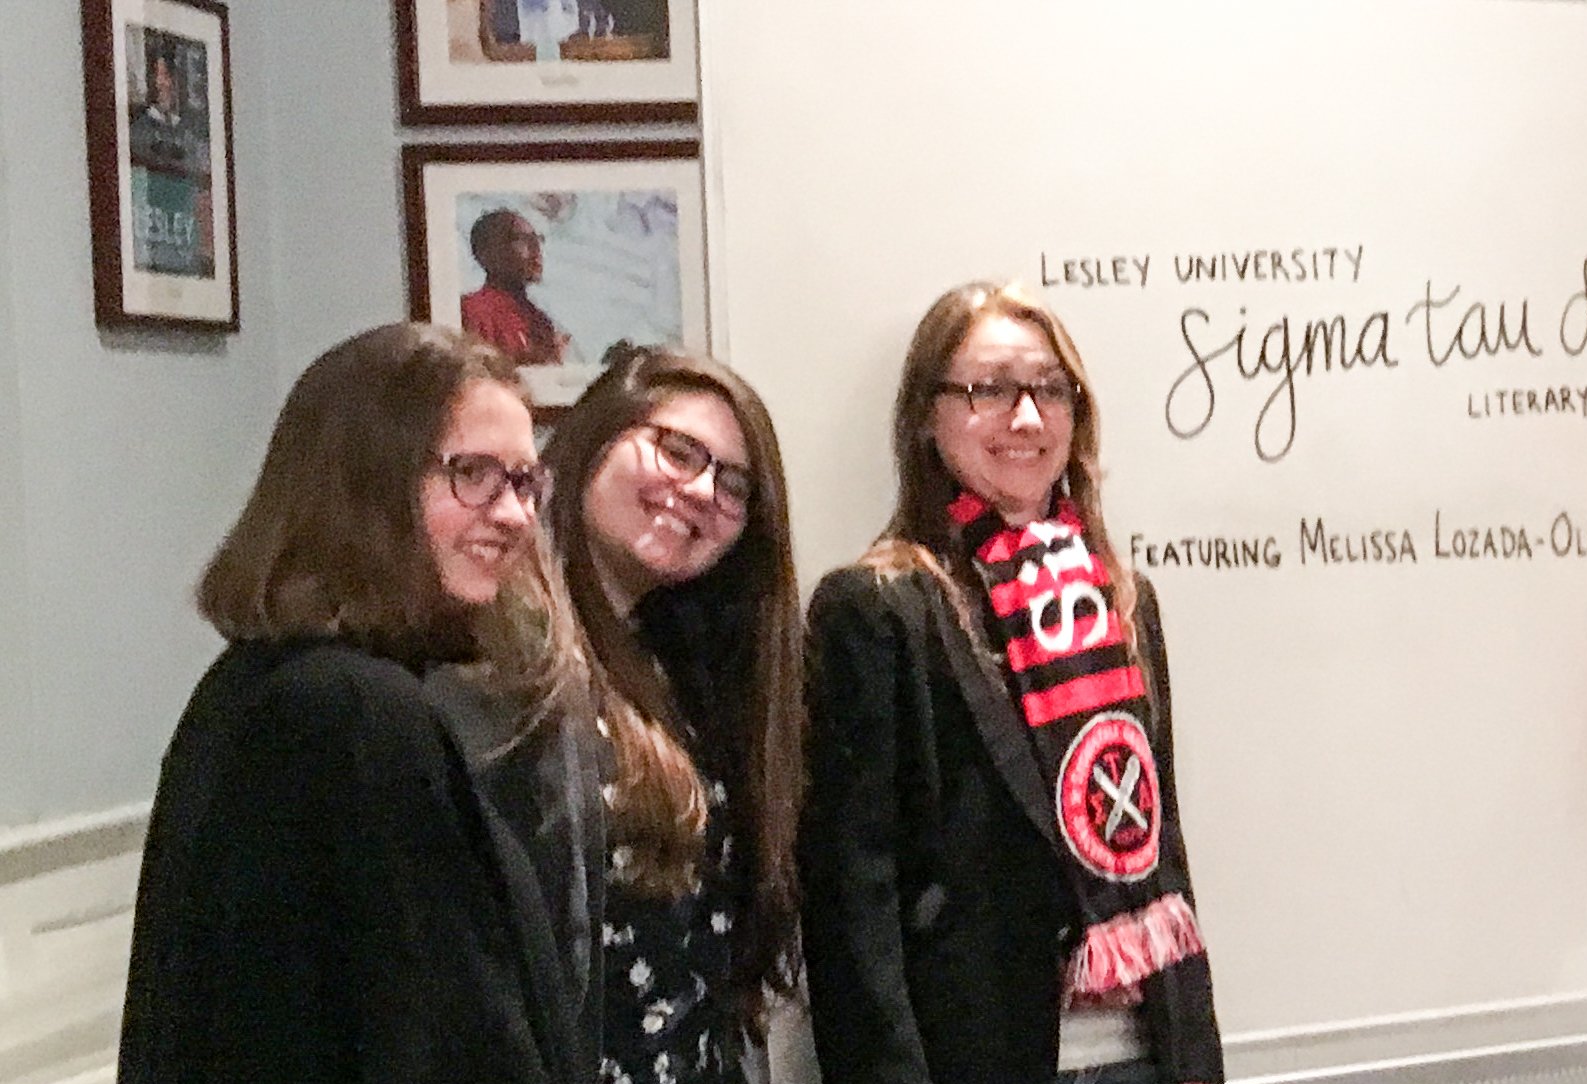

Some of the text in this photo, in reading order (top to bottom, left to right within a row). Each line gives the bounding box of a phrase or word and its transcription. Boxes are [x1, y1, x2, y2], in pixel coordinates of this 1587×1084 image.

[1040, 244, 1364, 290] LESLEY UNIVERSITY
[1405, 279, 1544, 369] tau
[1130, 532, 1282, 568] FEATURING
[1299, 516, 1418, 566] MELISSA
